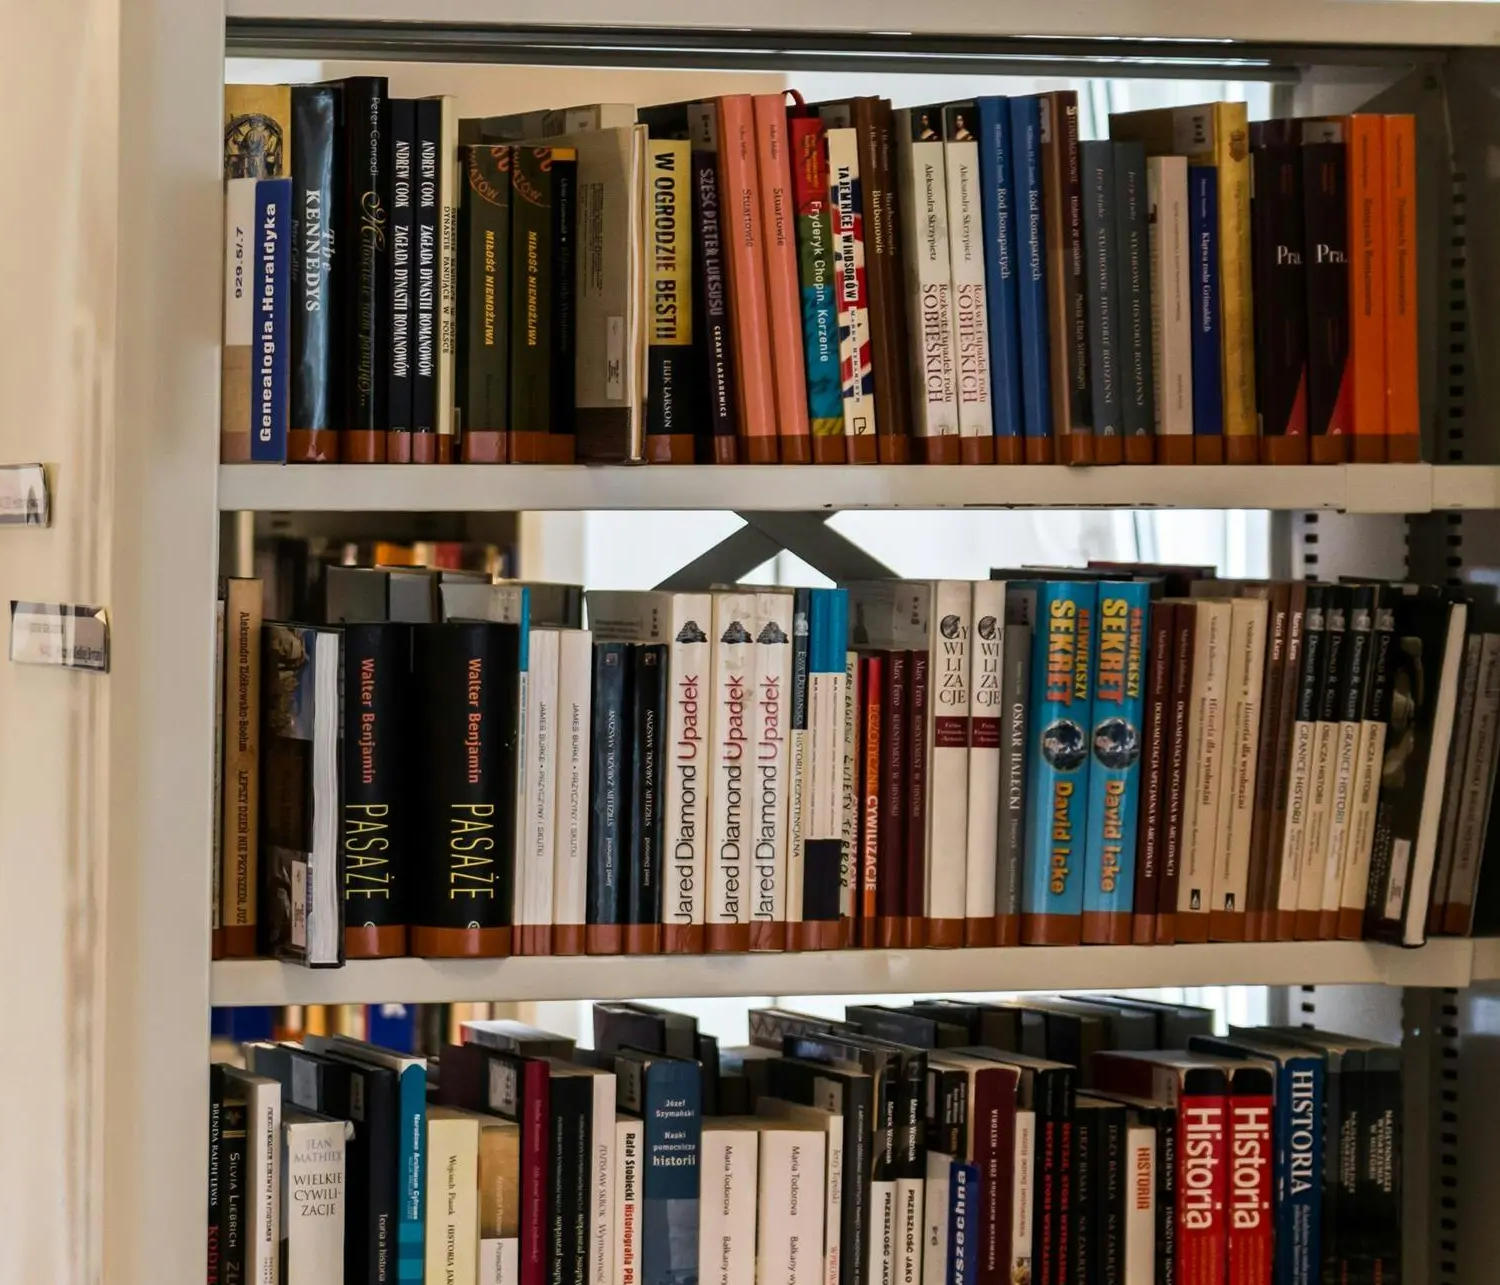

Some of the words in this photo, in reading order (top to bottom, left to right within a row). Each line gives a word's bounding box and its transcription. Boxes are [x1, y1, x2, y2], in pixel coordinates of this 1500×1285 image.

[370, 97, 381, 126] Peter
[369, 129, 380, 177] Conradi
[395, 140, 409, 179] ANDREW
[421, 140, 435, 179] ANDREW
[654, 152, 675, 171] W
[394, 182, 409, 208] COOK
[421, 182, 435, 208] COOK
[699, 169, 717, 207] SZEŚĆ
[837, 166, 854, 229] TAJEMNICE
[924, 163, 935, 213] Aleksandra
[959, 164, 970, 213] Aleksandra
[997, 188, 1008, 209] Ród
[1029, 190, 1039, 211] Ród
[442, 206, 451, 250] DYNASTIE
[654, 177, 677, 272] OGRODZIE
[700, 210, 718, 257] PIĘTER
[742, 188, 755, 248] Stuartowie
[773, 187, 786, 247] Stuartowie
[808, 201, 826, 256] Fryderyk
[872, 189, 886, 254] Burbonowie
[927, 214, 939, 261] Skrzypietz
[961, 214, 973, 262] Skrzypietz
[305, 189, 321, 312] KENNEDYS
[321, 229, 336, 271] The
[393, 224, 408, 265] ZAGŁADA
[419, 224, 434, 265] ZAGŁADA
[484, 229, 496, 273] MIŁOŚĆ
[527, 231, 539, 274] MIŁOŚĆ
[840, 233, 860, 300] WINDSORÓW
[998, 212, 1011, 279] Bonapartych
[1029, 214, 1042, 281] Bonapartych
[392, 268, 407, 310] DYNASTII
[418, 268, 434, 310] DYNASTII
[440, 256, 451, 300] PANUJĄCE
[704, 260, 723, 316] LUKSUSU
[811, 260, 828, 306] Chopin.
[259, 204, 277, 442] Genealogia.Heraldyka
[442, 306, 451, 315] W
[484, 275, 495, 346] NIEMOŻLIWA
[526, 276, 538, 347] NIEMOŻLIWA
[655, 279, 678, 339] BESTII
[1202, 284, 1212, 332] Grimaldich
[391, 313, 409, 377] ROMANOWÓW
[417, 313, 436, 377] ROMANOWÓW
[442, 320, 451, 354] POLSCE
[817, 309, 831, 363] Korzenie
[923, 283, 944, 404] SOBIESKICH
[958, 283, 978, 404] SOBIESKICH
[663, 359, 673, 384] ERIK
[663, 387, 674, 429] LARSON
[239, 612, 250, 664] Aleksandra
[943, 642, 965, 656] WI
[981, 643, 1001, 657] WI
[1046, 599, 1076, 706] SEKRET
[1075, 609, 1090, 700] NAJWIĘKSZY
[1098, 599, 1128, 706] SEKRET
[362, 658, 376, 707] Walter
[468, 658, 482, 707] Walter
[943, 674, 964, 688] ZA
[946, 658, 961, 672] LI
[981, 674, 999, 688] ZA
[984, 659, 998, 673] LI
[676, 674, 702, 761] Upadek
[721, 675, 748, 761] Upadek
[756, 675, 783, 761] Upadek
[939, 690, 966, 706] CJE
[977, 690, 1001, 707] CJE
[1205, 698, 1218, 737] Historia
[1240, 702, 1254, 741] Historia
[358, 712, 376, 784] Benjamin
[464, 712, 482, 784] Benjamin
[868, 704, 880, 791] EGZOTYCZNE
[1012, 703, 1024, 747] OSKAR
[1151, 701, 1164, 769] DOKUMENTACJA
[1172, 700, 1186, 768] DOKUMENTACJA
[1205, 739, 1214, 755] dla
[1319, 724, 1331, 763] OBLICZA
[1366, 724, 1378, 763] OBLICZA
[1240, 743, 1251, 758] dla
[1296, 724, 1310, 774] GRANICE
[1340, 724, 1354, 774] GRANICE
[238, 770, 248, 804] LEPSZY
[1010, 752, 1023, 810] HALECKI
[1149, 770, 1160, 813] SPECJALNA
[1170, 769, 1181, 813] SPECJALNA
[1200, 756, 1213, 806] wyobraźni
[1236, 760, 1248, 810] wyobraźni
[1291, 776, 1305, 825] HISTORII
[1314, 764, 1328, 805] HISTORII
[1334, 776, 1348, 824] HISTORII
[1361, 764, 1374, 804] HISTORII
[237, 806, 250, 834] DZIEŃ
[675, 765, 696, 860] Diamond
[720, 765, 743, 860] Diamond
[755, 765, 778, 860] Diamond
[1052, 781, 1074, 841] David
[1104, 780, 1126, 839] David
[1148, 815, 1157, 824] W
[1170, 814, 1178, 824] W
[237, 835, 248, 852] NIE
[345, 804, 395, 900] PASAŻE
[450, 804, 500, 900] PASAŻE
[865, 795, 878, 891] CYWILIZACJE
[1144, 825, 1156, 878] ARCHIWACH
[1166, 825, 1177, 877] ARCHIWACH
[1051, 847, 1073, 895] Icke
[1100, 845, 1121, 893] Icke
[676, 865, 693, 924] Jared
[720, 865, 740, 924] Jared
[754, 865, 775, 922] Jared
[212, 1103, 220, 1142] BRENDA
[655, 1109, 695, 1117] Szymański
[665, 1099, 686, 1108] Józef
[886, 1101, 895, 1127] Marek
[909, 1099, 918, 1124] Marek
[625, 1133, 635, 1157] Rafał
[885, 1129, 894, 1164] Woźniak
[908, 1126, 918, 1162] Woźniak
[1290, 1070, 1314, 1195] HISTORIA
[211, 1145, 219, 1175] RALPH
[293, 1172, 343, 1184] WIELKIE
[447, 1155, 457, 1190] Wojciech
[624, 1160, 635, 1201] Stobiecki
[652, 1155, 696, 1166] historii
[1136, 1147, 1152, 1210] HISTORIA
[1185, 1107, 1222, 1230] Historia
[1233, 1107, 1269, 1229] Historia
[301, 1203, 336, 1217] ZACJE
[378, 1213, 389, 1240] Teoria
[448, 1192, 456, 1216] Piasek
[882, 1192, 893, 1256] PRZESZŁOŚĆ
[906, 1189, 916, 1253] PRZESZŁOŚĆ
[447, 1224, 455, 1267] HISTORIA
[623, 1203, 634, 1265] Historiografia
[988, 1223, 996, 1270] Vademecum
[379, 1249, 388, 1282] historia
[882, 1259, 890, 1285] JAKO
[905, 1256, 915, 1283] JAKO
